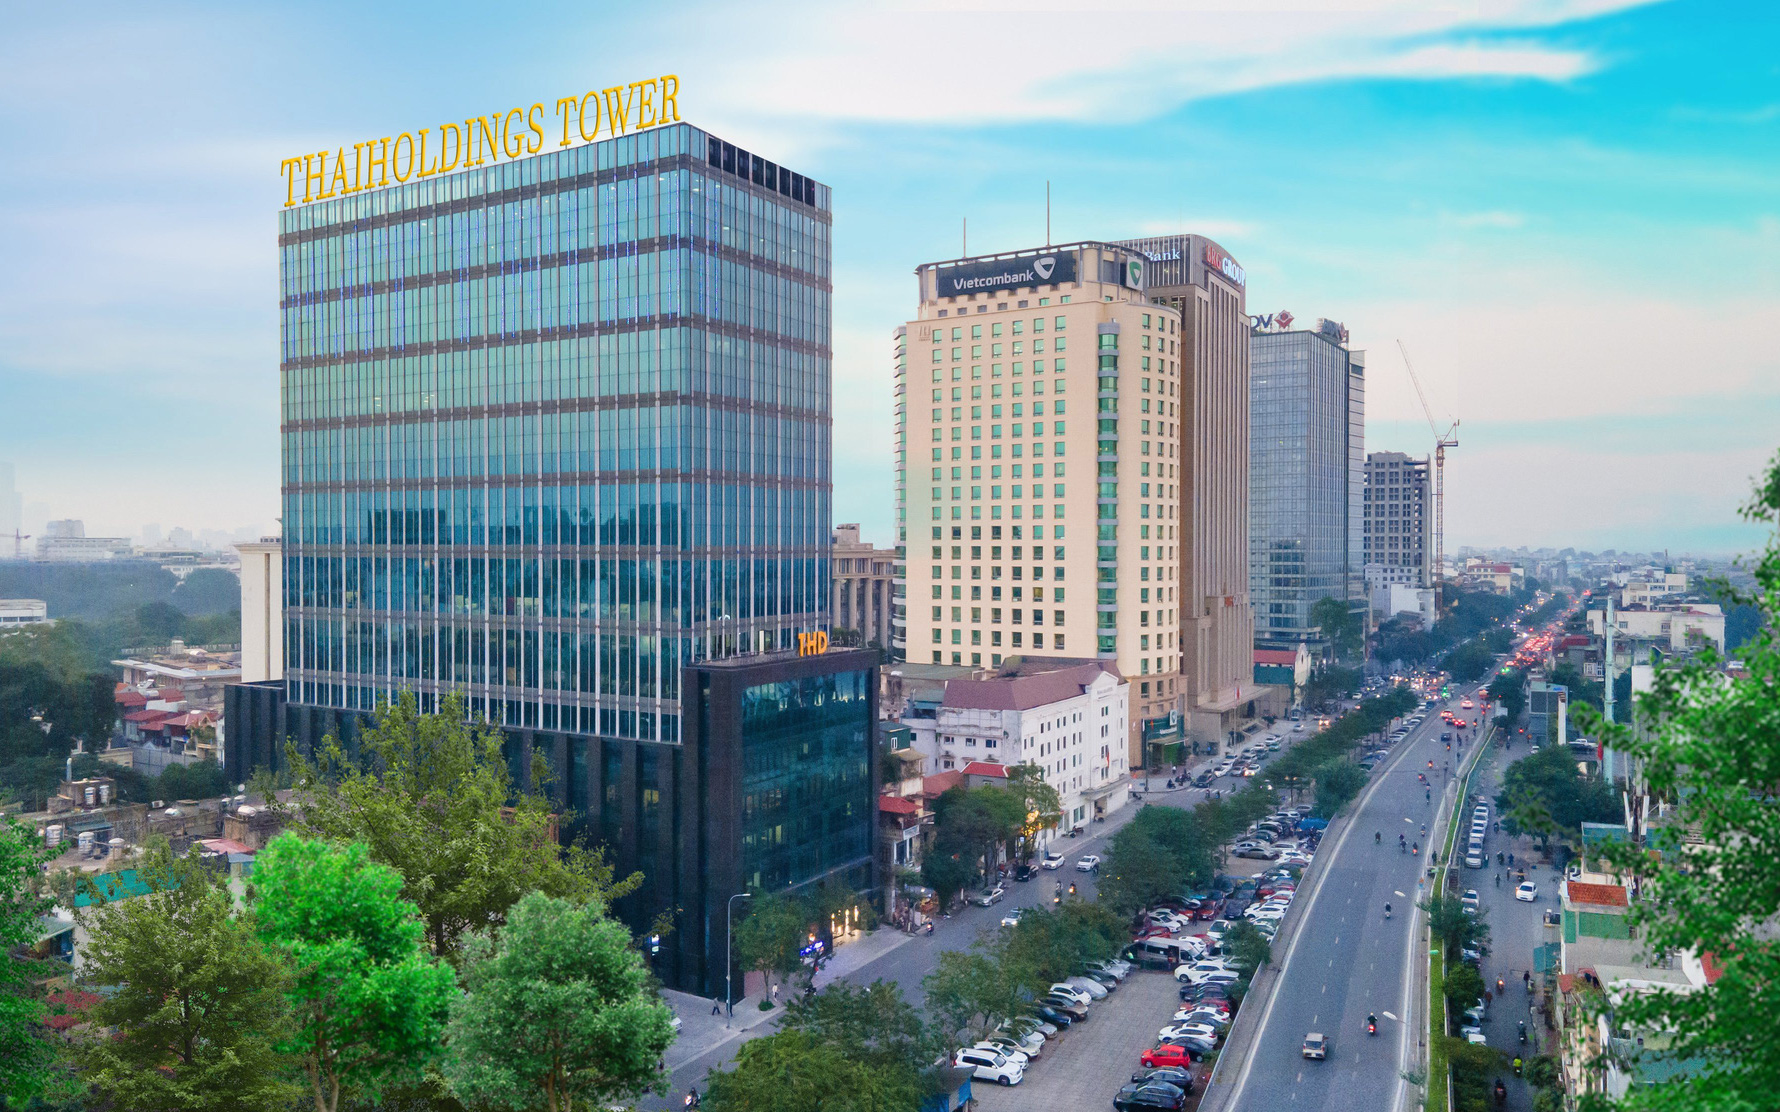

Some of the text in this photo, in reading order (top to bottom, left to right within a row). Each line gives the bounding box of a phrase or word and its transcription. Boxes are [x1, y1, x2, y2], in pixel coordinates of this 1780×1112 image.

[280, 74, 681, 207] THAIHOLDINGS TOWER
[953, 269, 1035, 290] Vietcombank
[1206, 244, 1246, 286] BRG GROUP
[798, 630, 828, 657] THD
